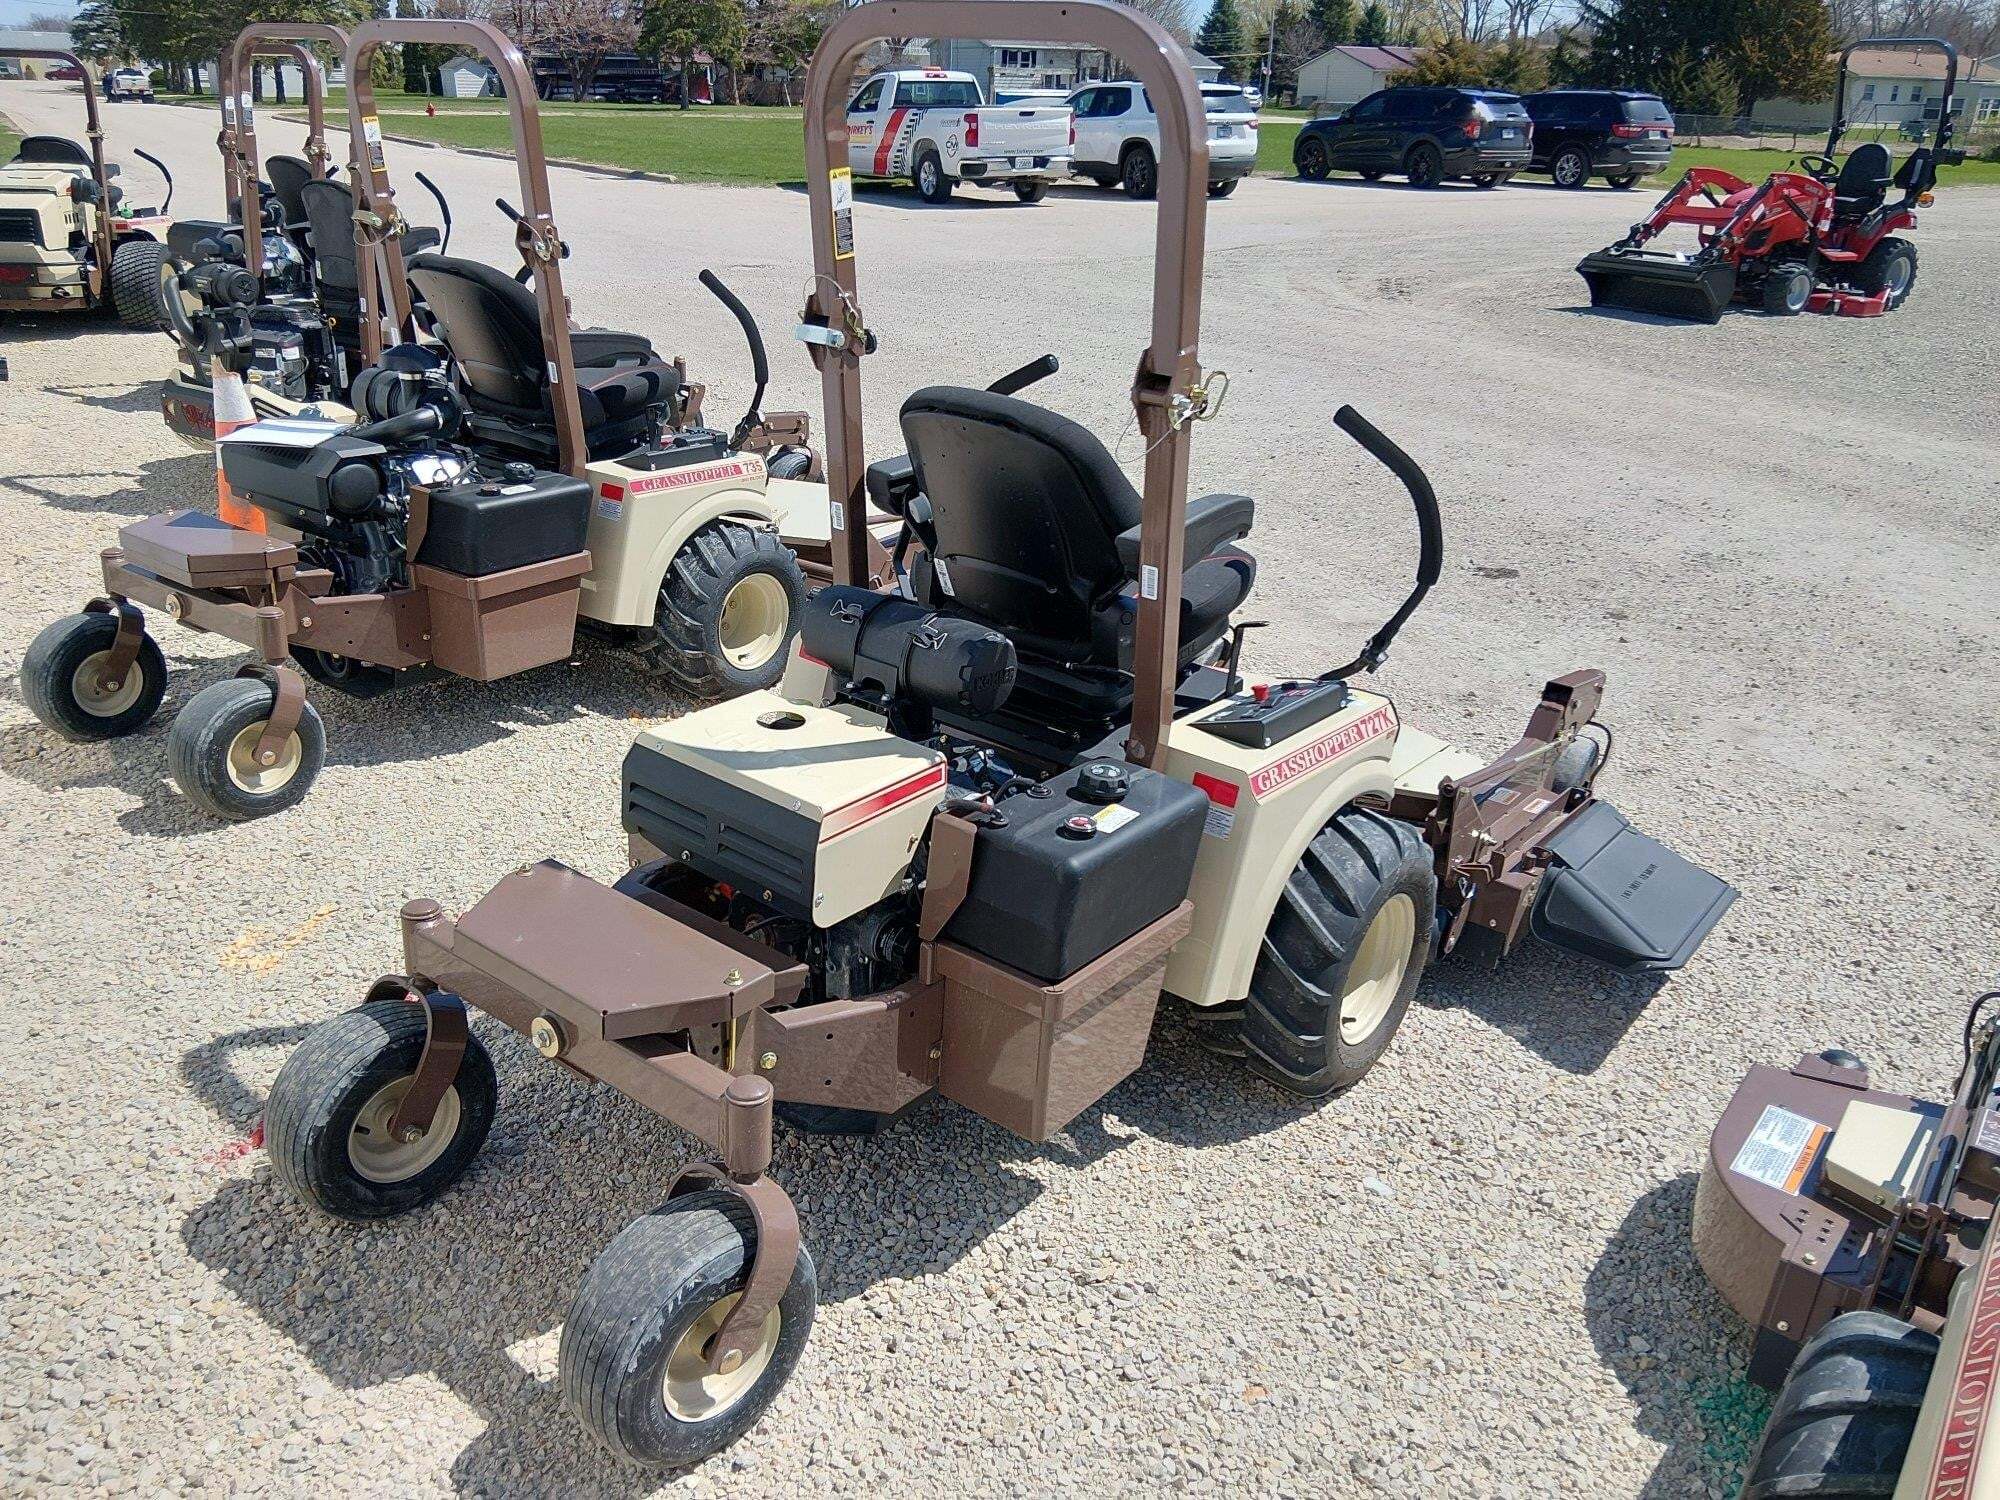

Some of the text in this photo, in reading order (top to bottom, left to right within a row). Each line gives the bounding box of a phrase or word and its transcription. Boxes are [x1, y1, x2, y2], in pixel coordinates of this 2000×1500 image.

[641, 461, 763, 491] GRASSHOPPER 735
[1257, 707, 1394, 791] GRASSHOPPER 727K
